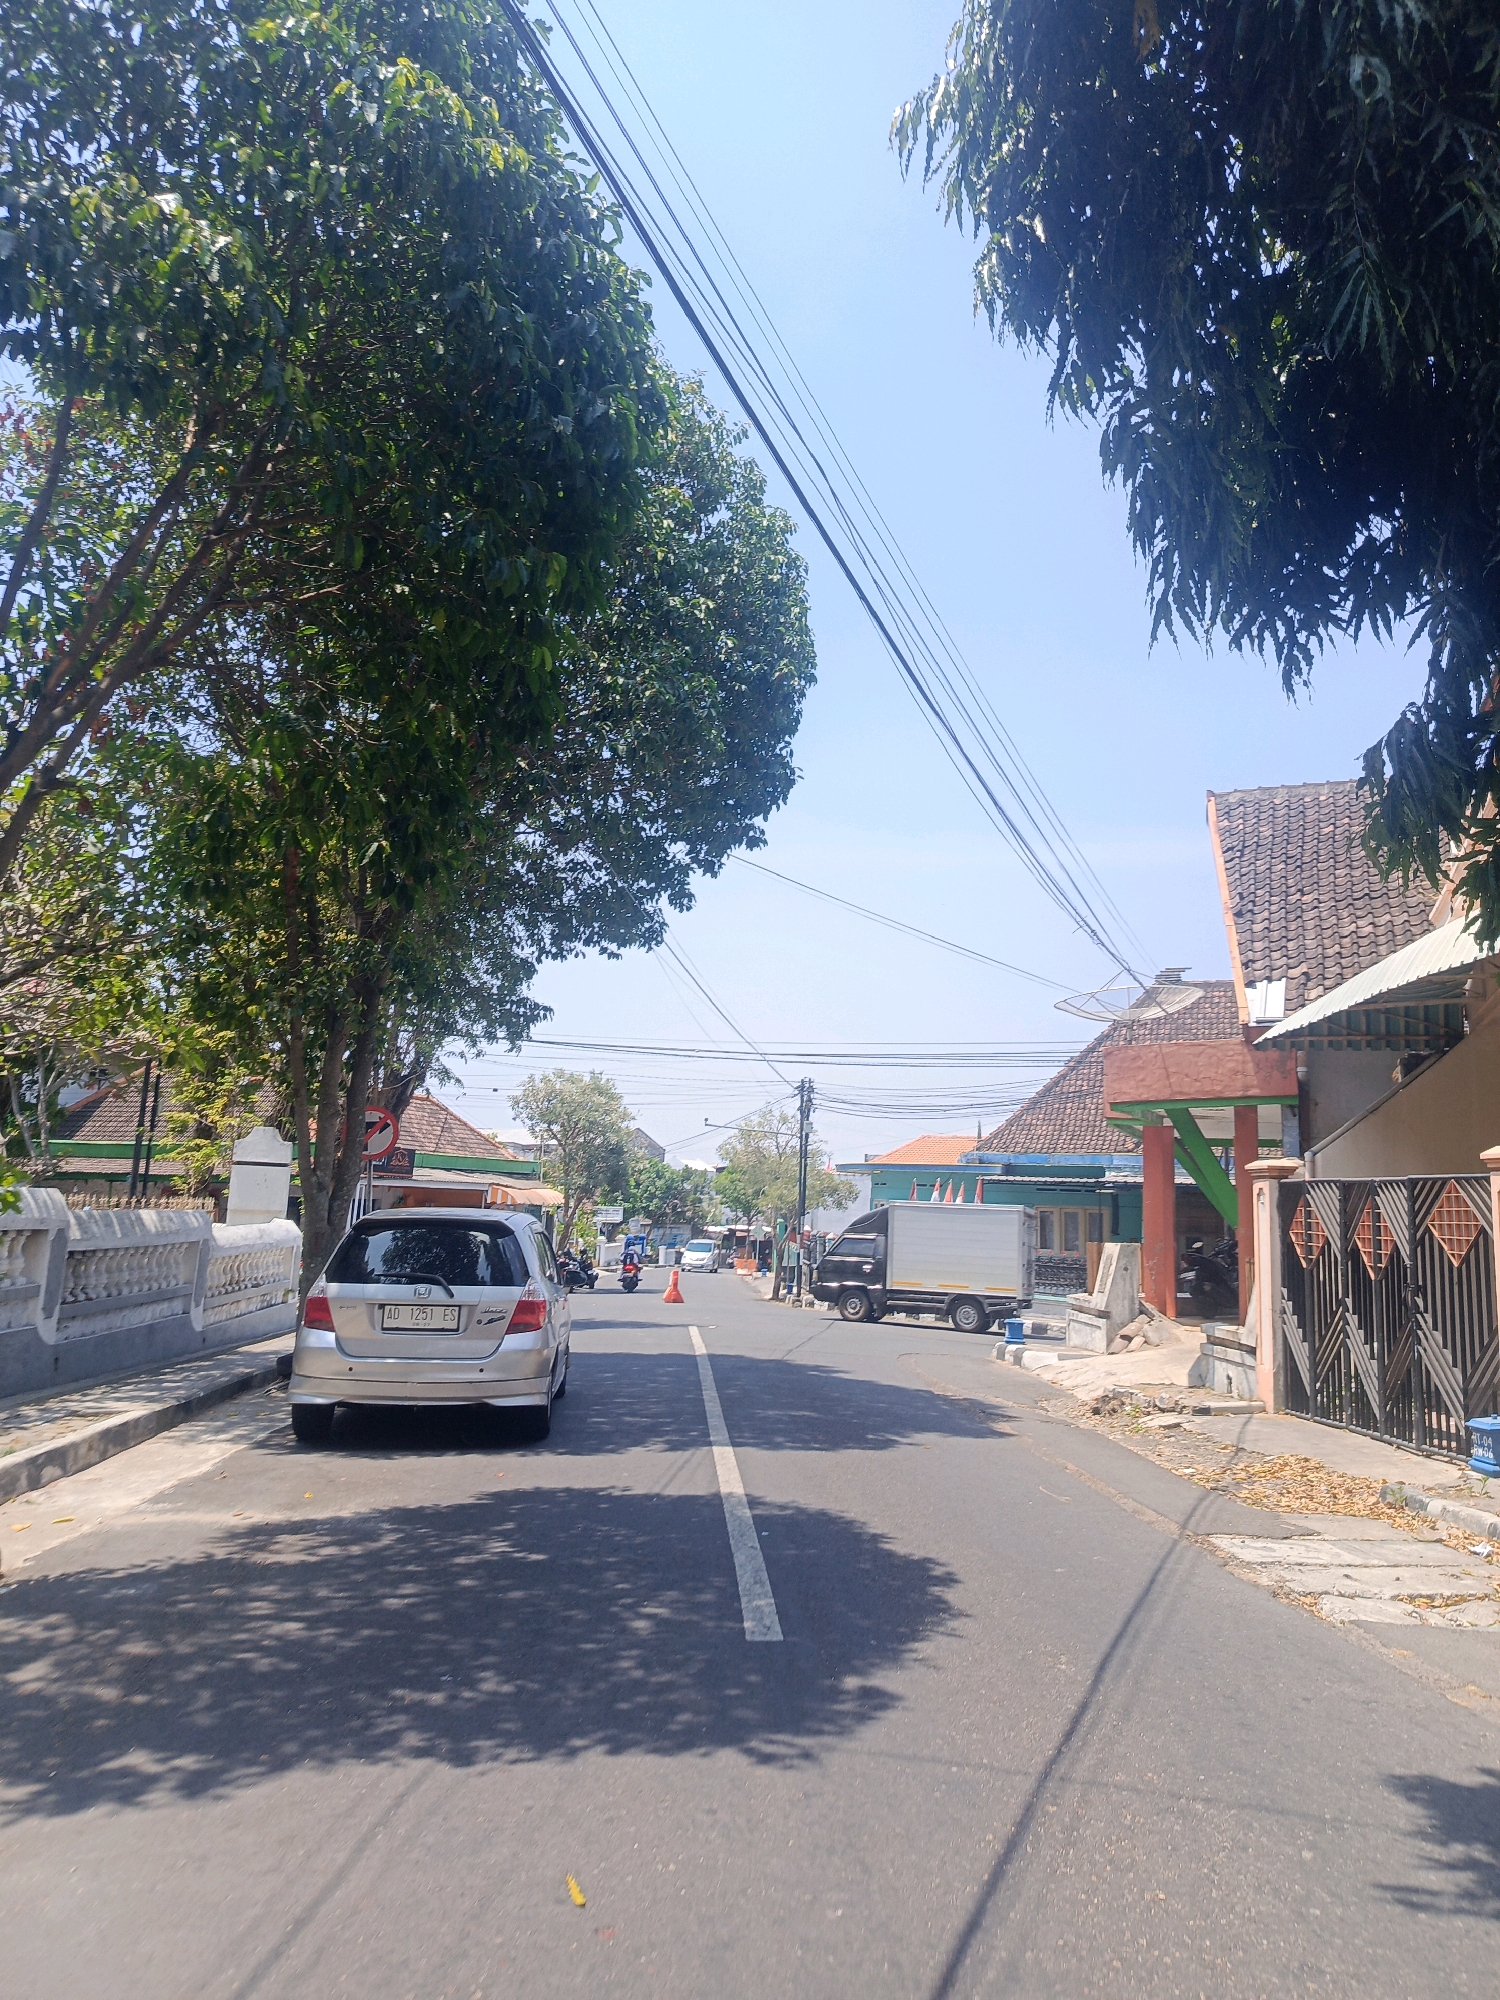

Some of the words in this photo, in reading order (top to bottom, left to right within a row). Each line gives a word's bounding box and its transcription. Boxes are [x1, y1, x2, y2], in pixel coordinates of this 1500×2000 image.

[386, 1307, 400, 1320] AD
[410, 1307, 433, 1321] 1251
[443, 1308, 456, 1322] ES
